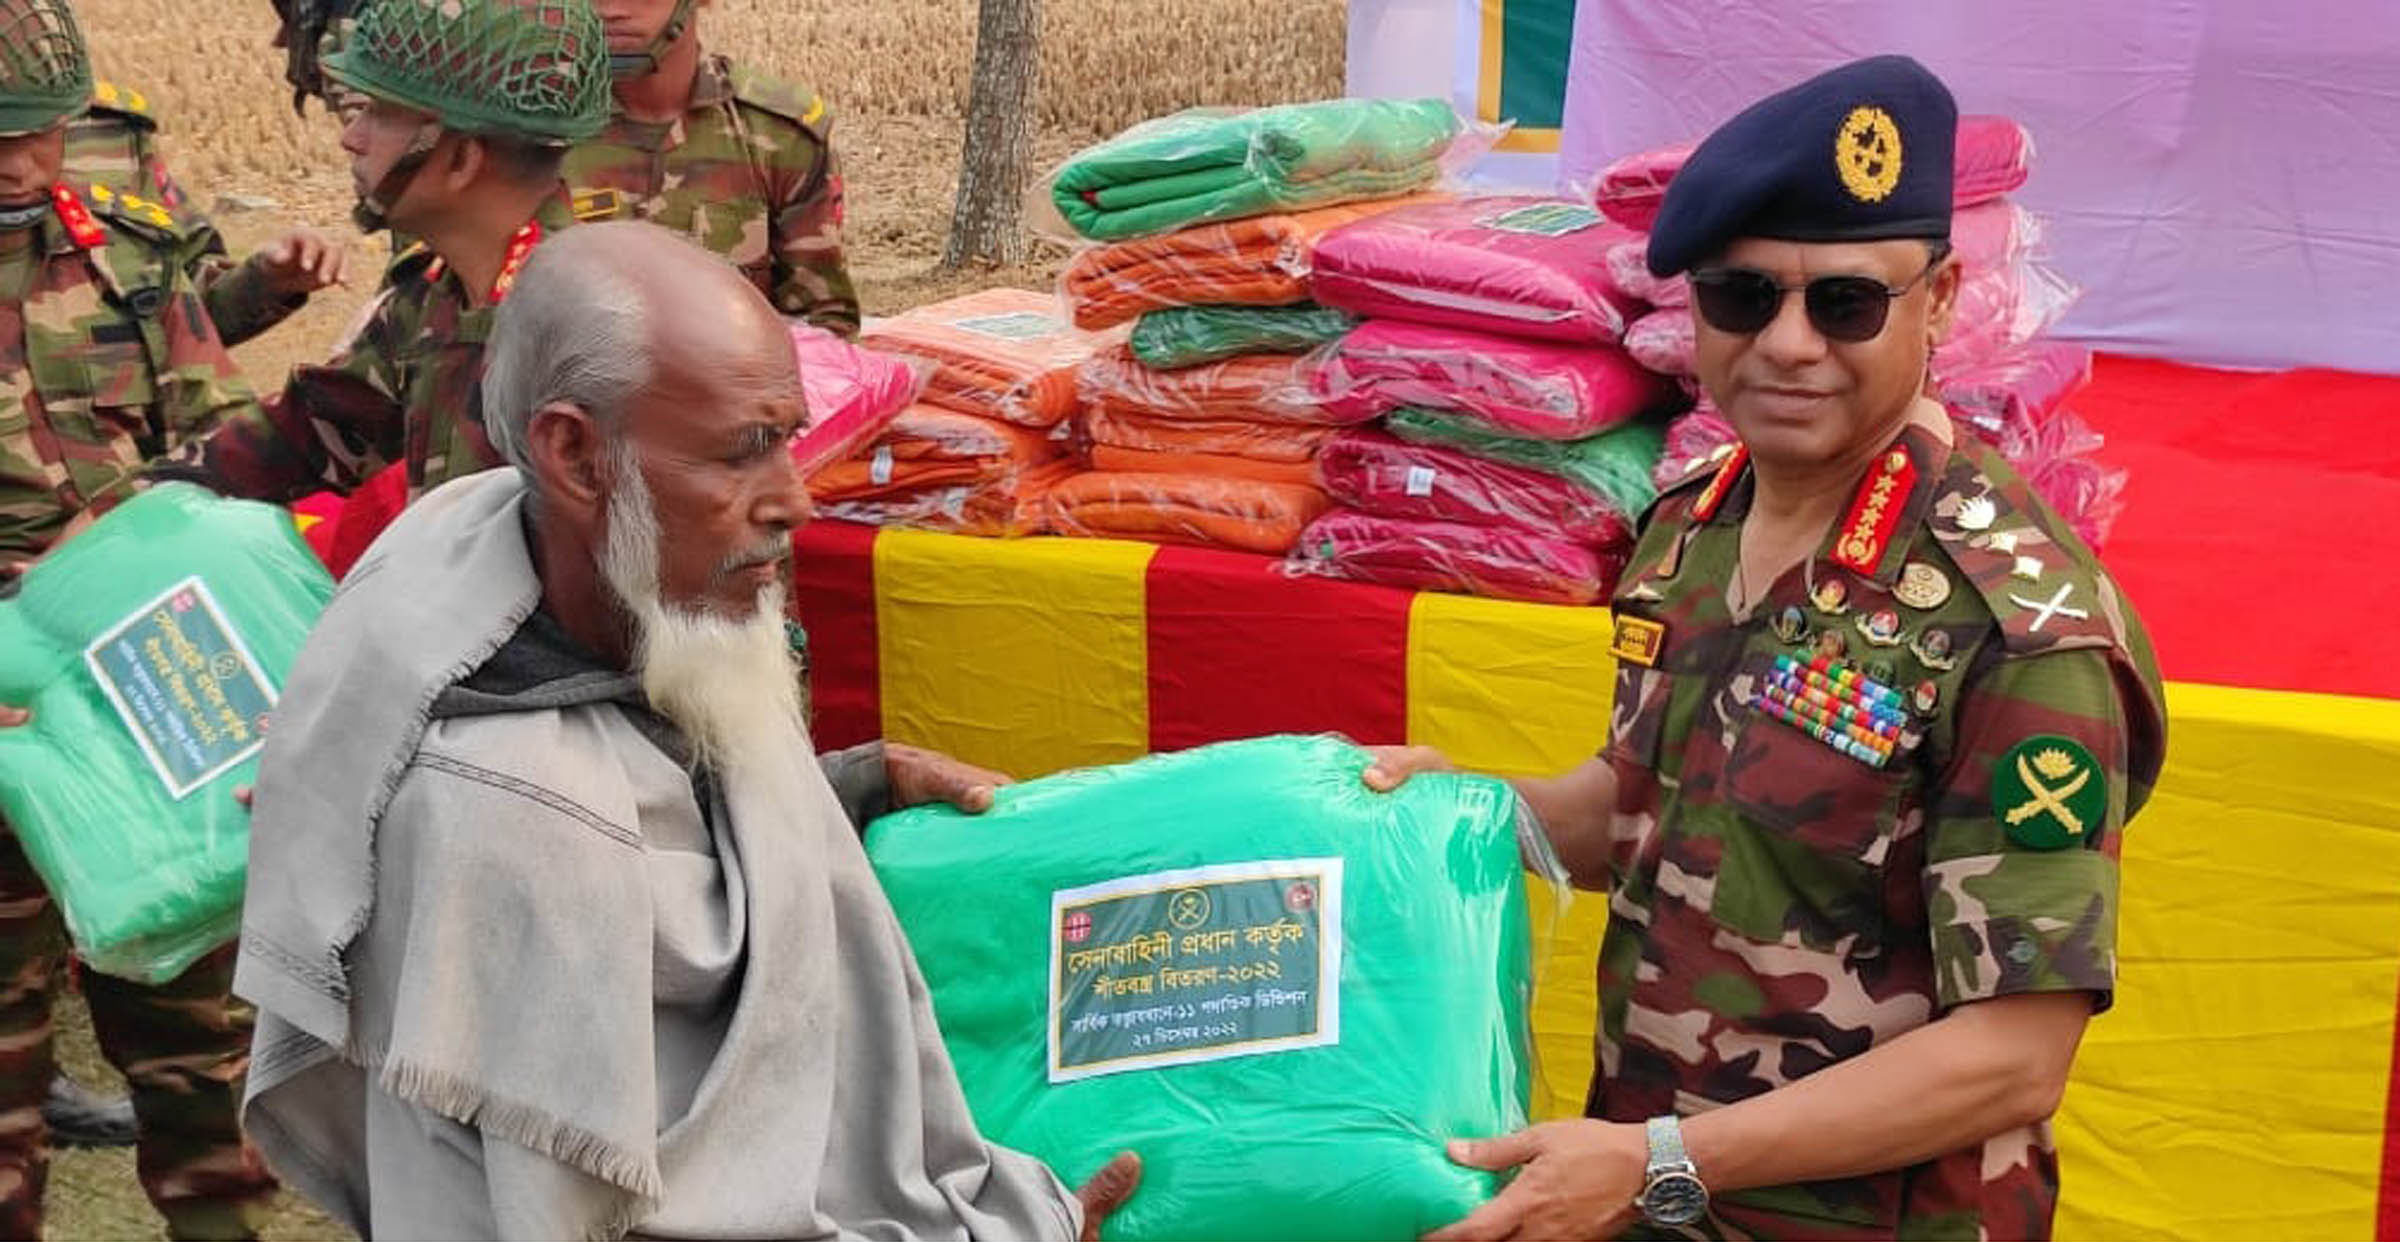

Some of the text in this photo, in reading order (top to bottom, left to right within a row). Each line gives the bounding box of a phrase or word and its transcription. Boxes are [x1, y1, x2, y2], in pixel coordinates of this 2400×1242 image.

[1067, 917, 1303, 973] সেনাবাহিনী প্রধান কর্তৃক
